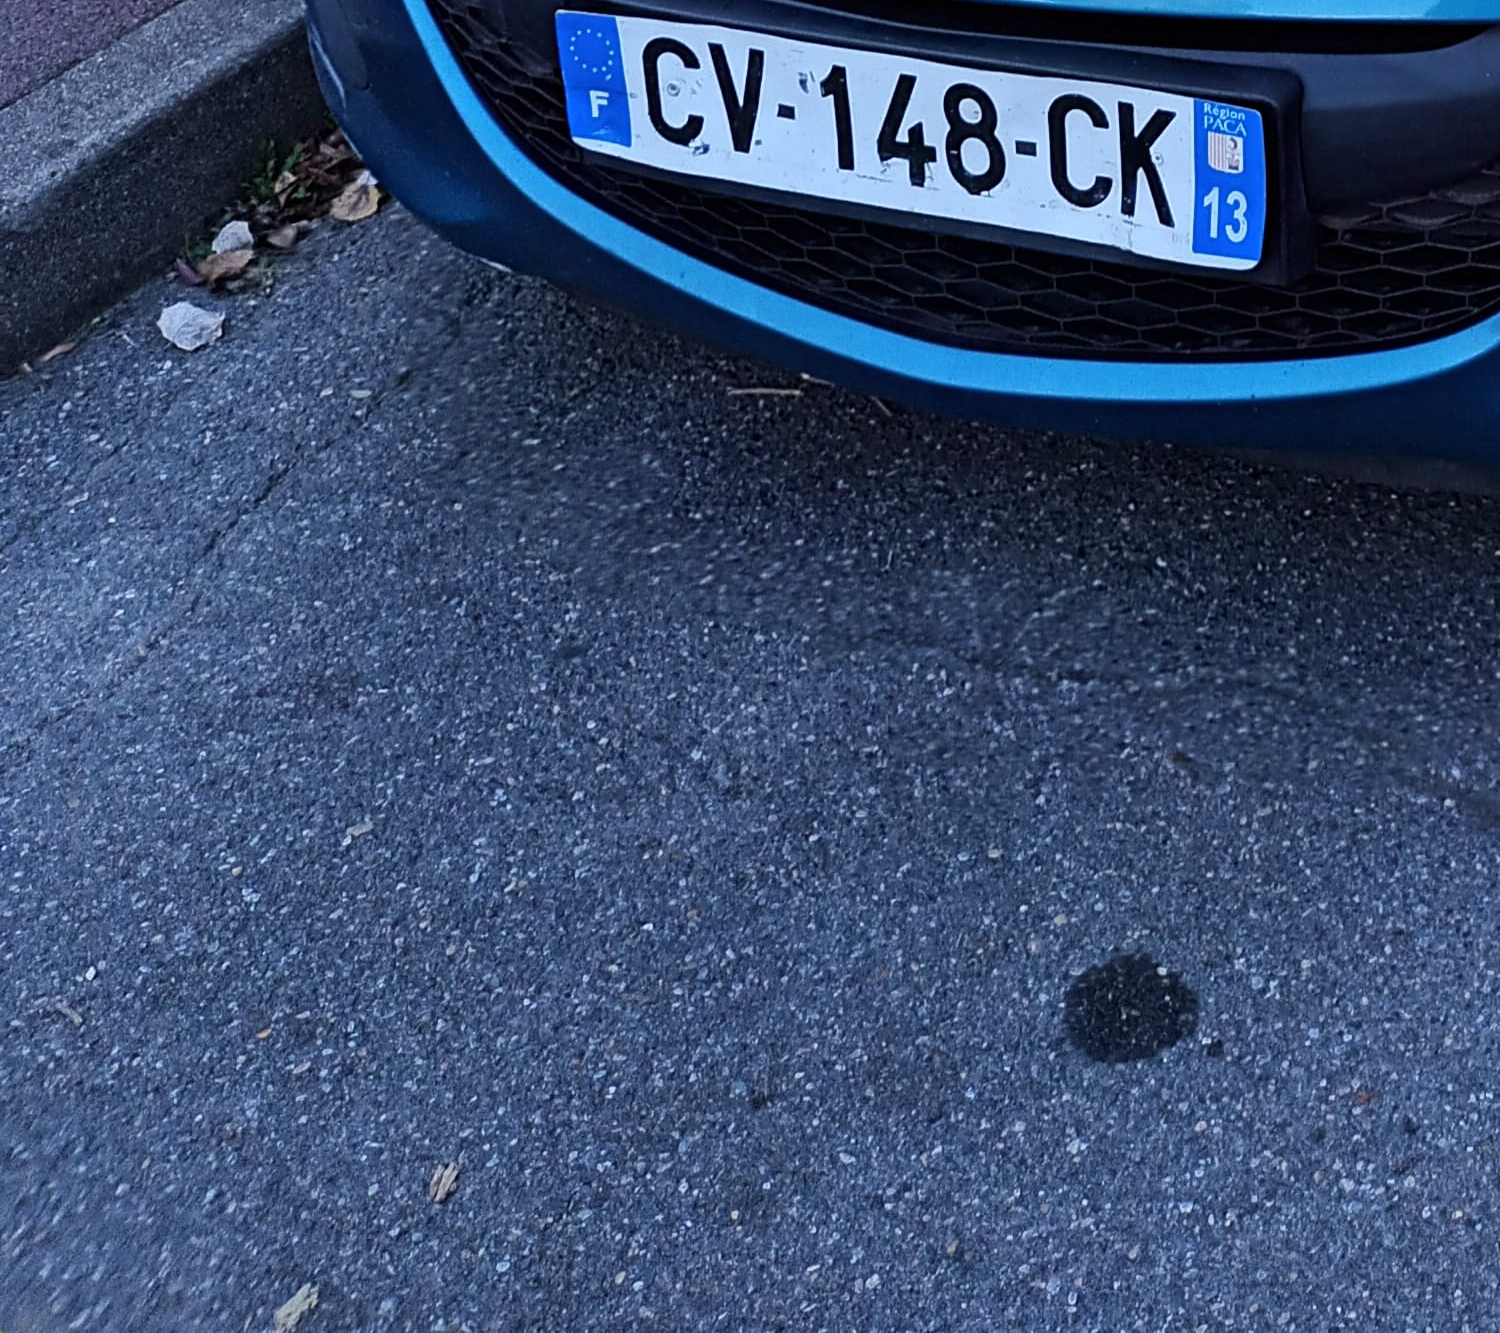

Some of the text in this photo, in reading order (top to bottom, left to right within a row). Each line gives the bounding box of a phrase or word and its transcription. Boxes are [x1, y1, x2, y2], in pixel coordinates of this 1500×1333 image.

[589, 89, 610, 118] F
[1203, 102, 1246, 121] Région
[642, 36, 1176, 228] CV-148-CK
[1203, 115, 1247, 137] PACA
[1203, 186, 1248, 243] 13
